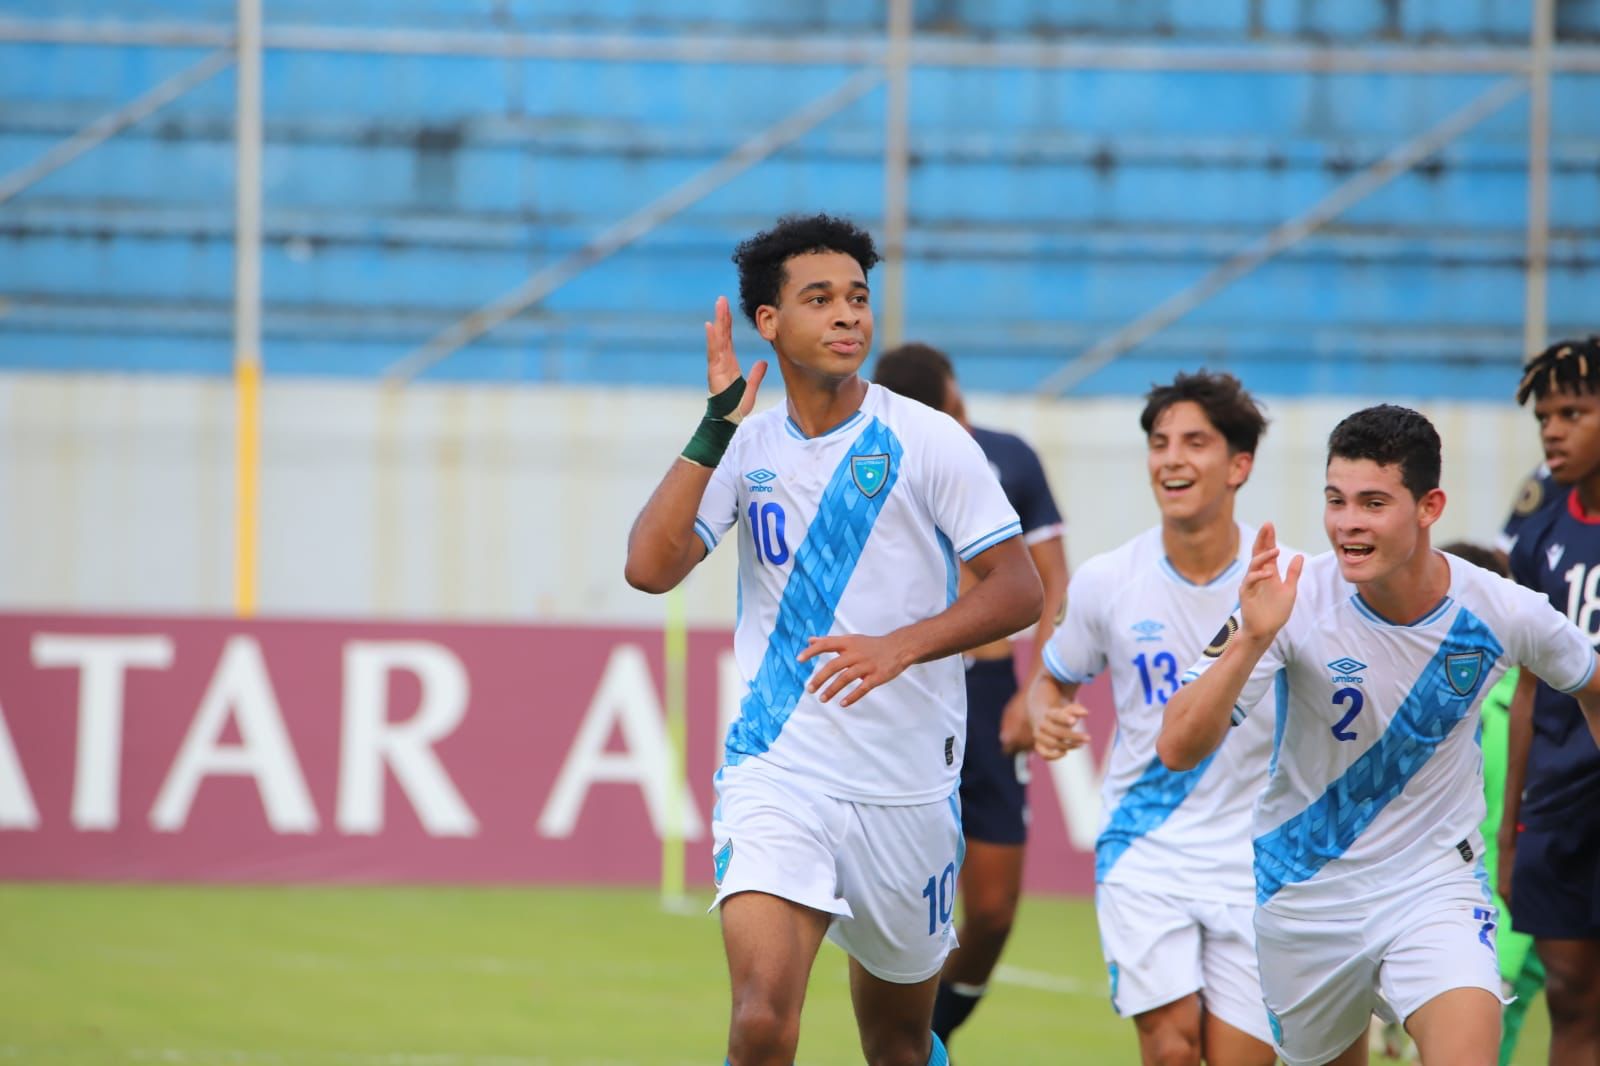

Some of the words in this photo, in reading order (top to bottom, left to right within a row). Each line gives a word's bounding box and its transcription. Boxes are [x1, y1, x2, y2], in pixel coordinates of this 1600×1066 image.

[748, 485, 773, 493] umbro
[748, 501, 790, 566] 10
[1564, 562, 1600, 647] 18
[1131, 651, 1180, 705] 13
[1331, 675, 1364, 684] umbro
[0, 632, 480, 838] TAR
[1330, 687, 1364, 742] 2
[922, 861, 955, 936] 10
